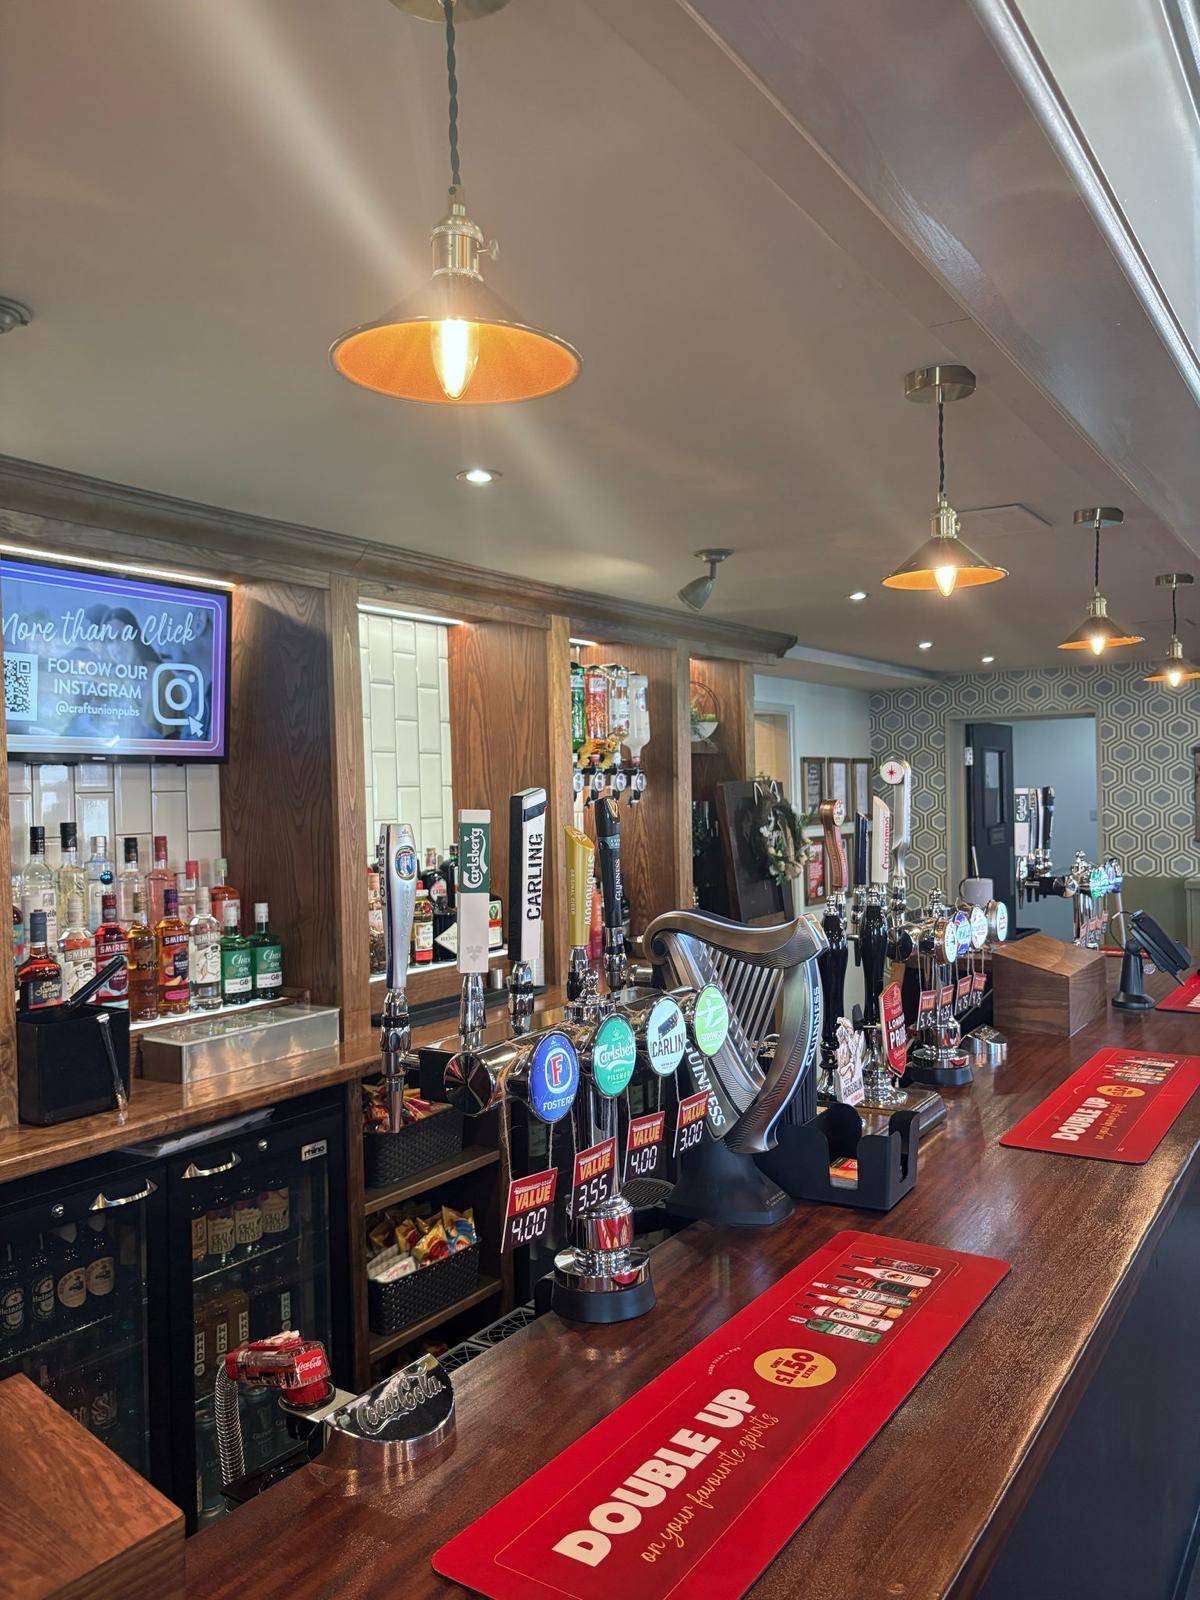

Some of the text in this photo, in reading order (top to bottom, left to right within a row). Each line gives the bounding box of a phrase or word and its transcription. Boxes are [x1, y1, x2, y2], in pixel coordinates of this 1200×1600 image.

[62, 608, 119, 646] than
[121, 628, 138, 643] a
[141, 611, 196, 646] Click
[48, 658, 148, 680] FOLLOW OUR
[54, 678, 142, 699] INSTAGRAM
[56, 701, 140, 719] @craftunionpubs
[462, 828, 487, 889] Carlsberg
[527, 832, 544, 921] CARLING
[615, 858, 624, 901] GUINNESS
[805, 986, 821, 1067] GUINNESS
[682, 1097, 707, 1122] VALUE
[1050, 1097, 1111, 1142] DOUBLE UP
[633, 1125, 661, 1148] VALUE
[579, 1153, 611, 1181] VALUE
[515, 1184, 552, 1212] VALUE
[770, 1356, 785, 1369] ONLY
[774, 1351, 815, 1385] £1.50
[801, 1364, 819, 1379] EXTRA
[552, 1388, 756, 1568] DOUBLE UP
[641, 1412, 779, 1563] on your favourite spirits
